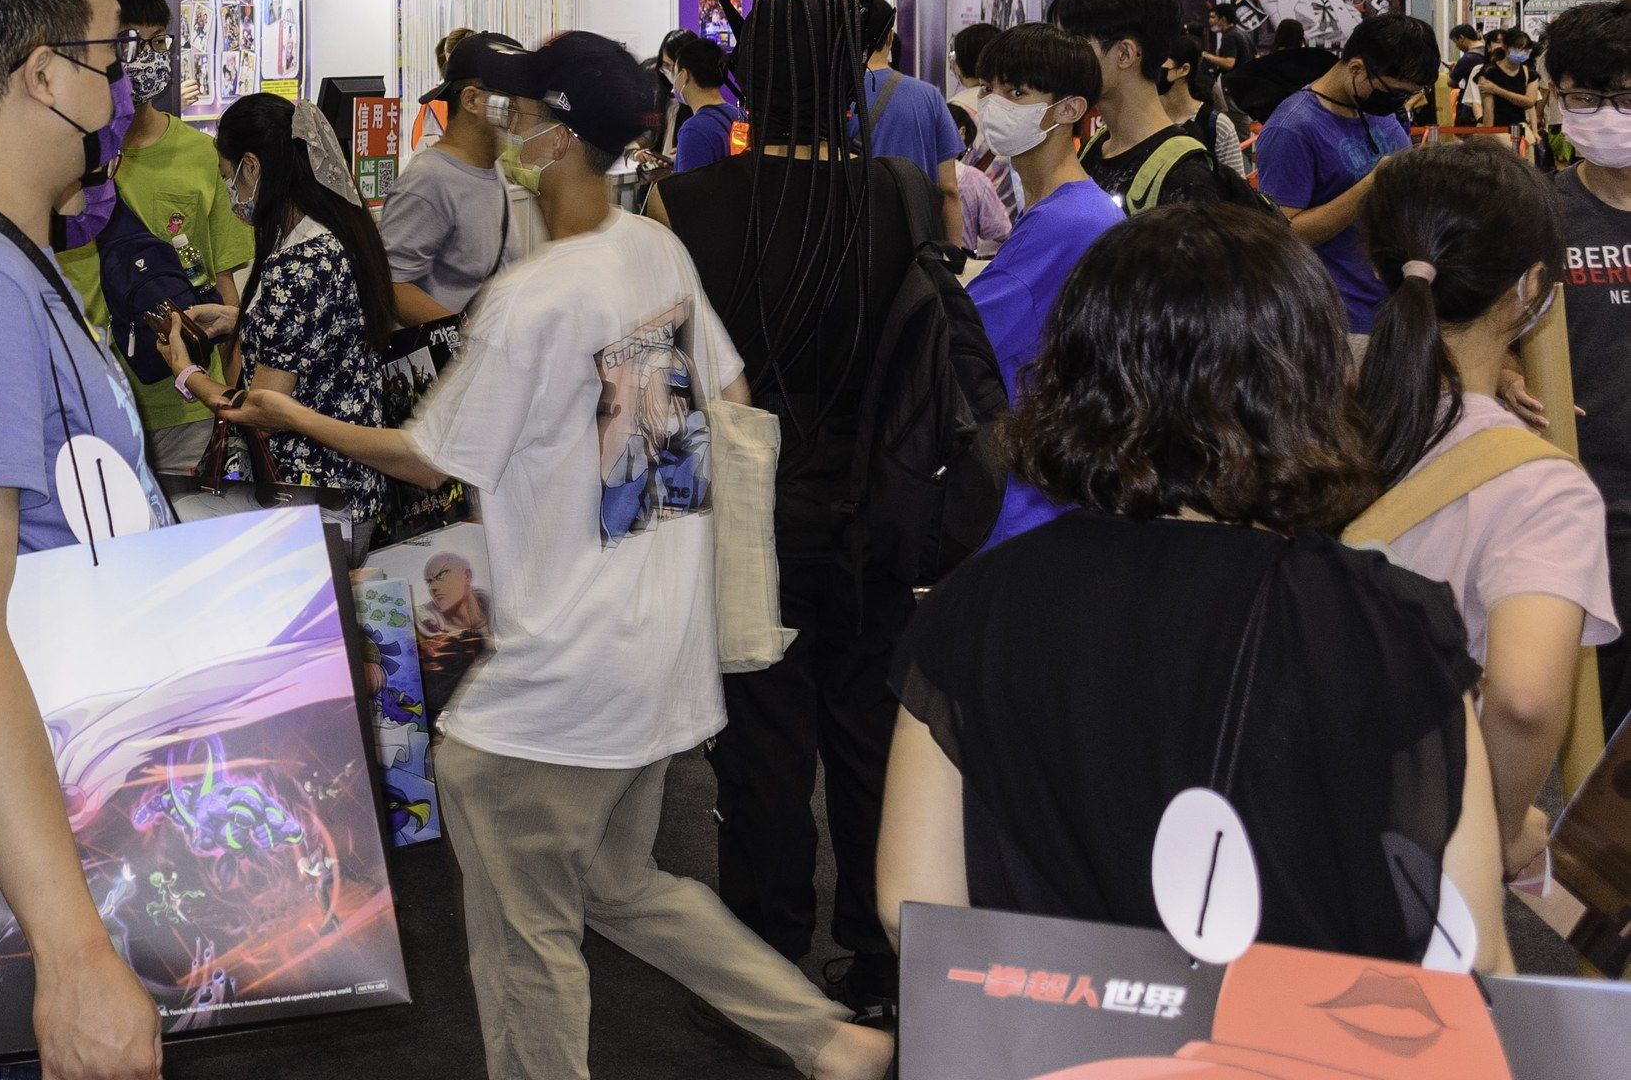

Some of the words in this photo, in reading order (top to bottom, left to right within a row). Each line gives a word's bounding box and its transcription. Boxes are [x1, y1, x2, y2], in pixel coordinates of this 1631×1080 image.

[357, 103, 398, 129] 信用卡
[357, 130, 397, 156] 現金
[360, 161, 375, 173] LINE
[361, 181, 374, 196] Pay
[947, 964, 1187, 1018] 一拳超人世界
